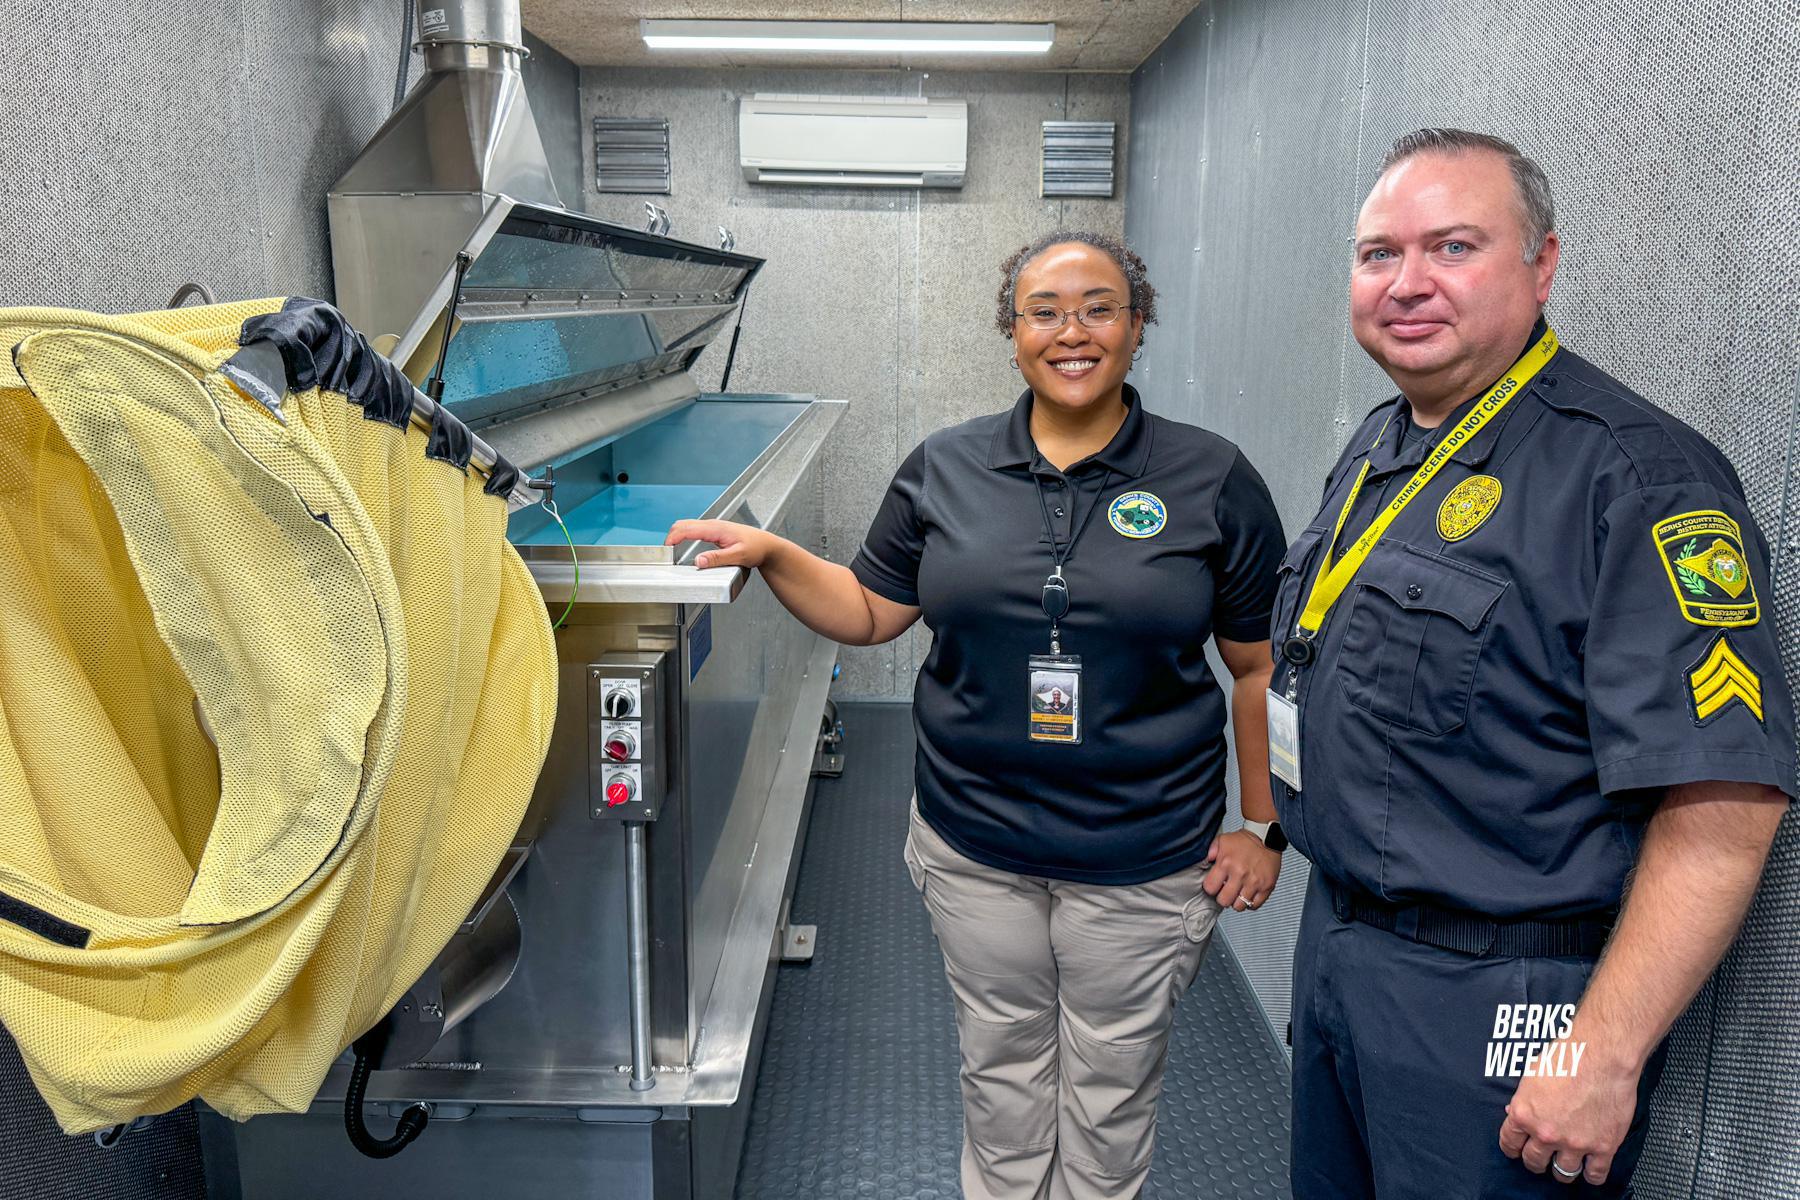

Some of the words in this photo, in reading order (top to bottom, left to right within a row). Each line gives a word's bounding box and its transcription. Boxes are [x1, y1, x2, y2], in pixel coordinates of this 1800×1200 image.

[1392, 479, 1421, 510] CRIME
[1419, 445, 1452, 479] SCENE
[1447, 431, 1465, 446] DO
[1462, 410, 1486, 432] NOT
[1483, 377, 1518, 412] CROSS
[1659, 521, 1682, 535] BERKS
[1682, 517, 1712, 527] COUNTY
[1677, 524, 1708, 534] DISTRICT
[1700, 607, 1749, 616] PENNSYLVANIA
